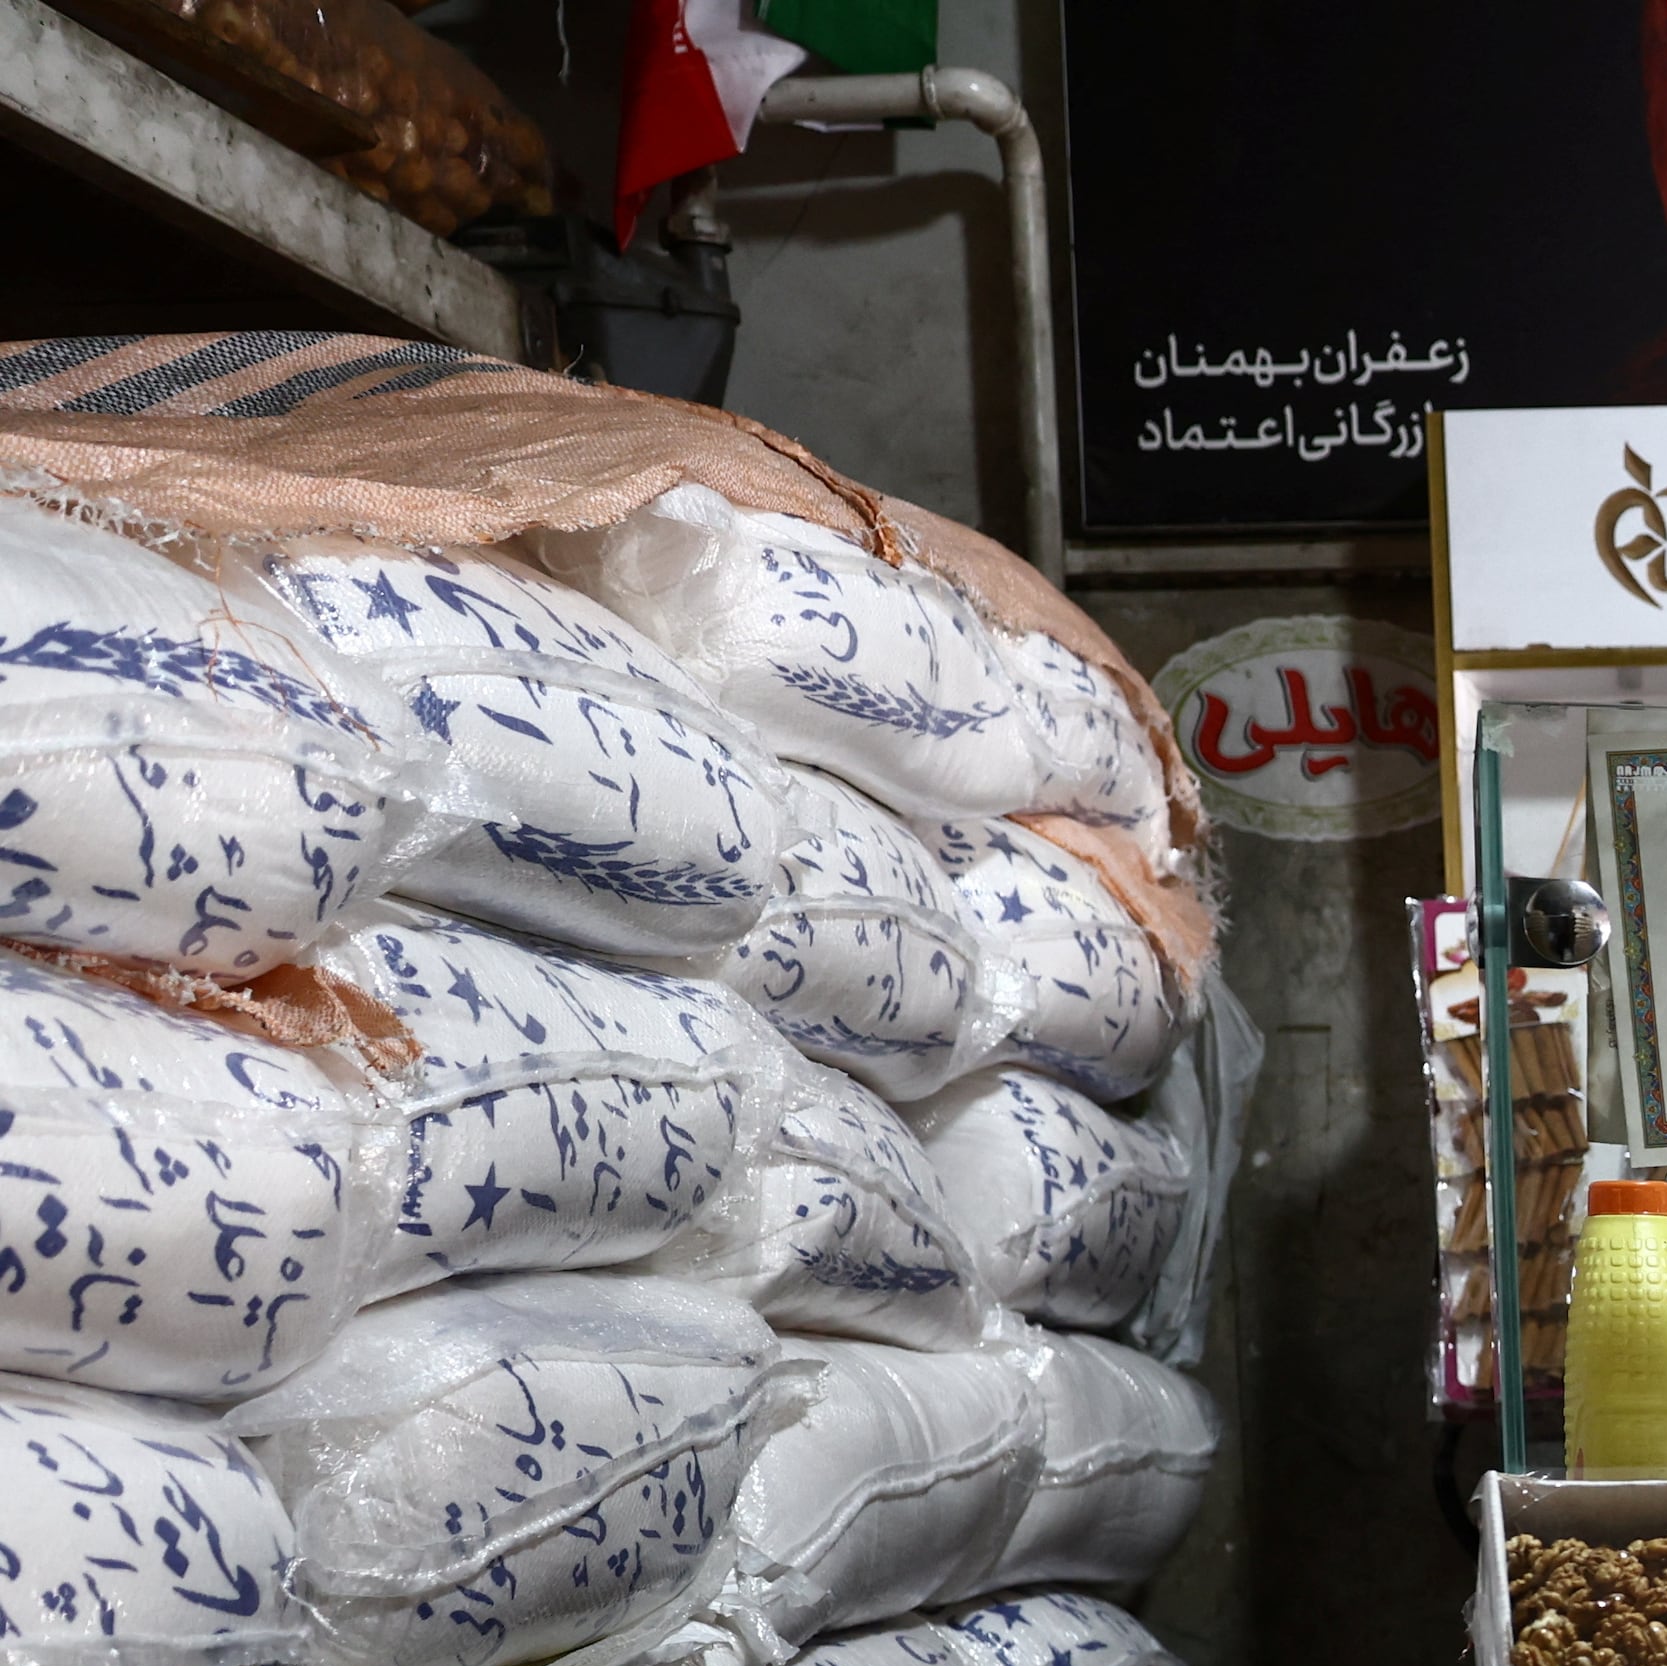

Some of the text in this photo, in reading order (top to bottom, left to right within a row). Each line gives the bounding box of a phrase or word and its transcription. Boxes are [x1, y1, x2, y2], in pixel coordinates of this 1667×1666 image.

[1134, 329, 1470, 388] زعفران بهمنان
[1139, 406, 1294, 452] اعتماد
